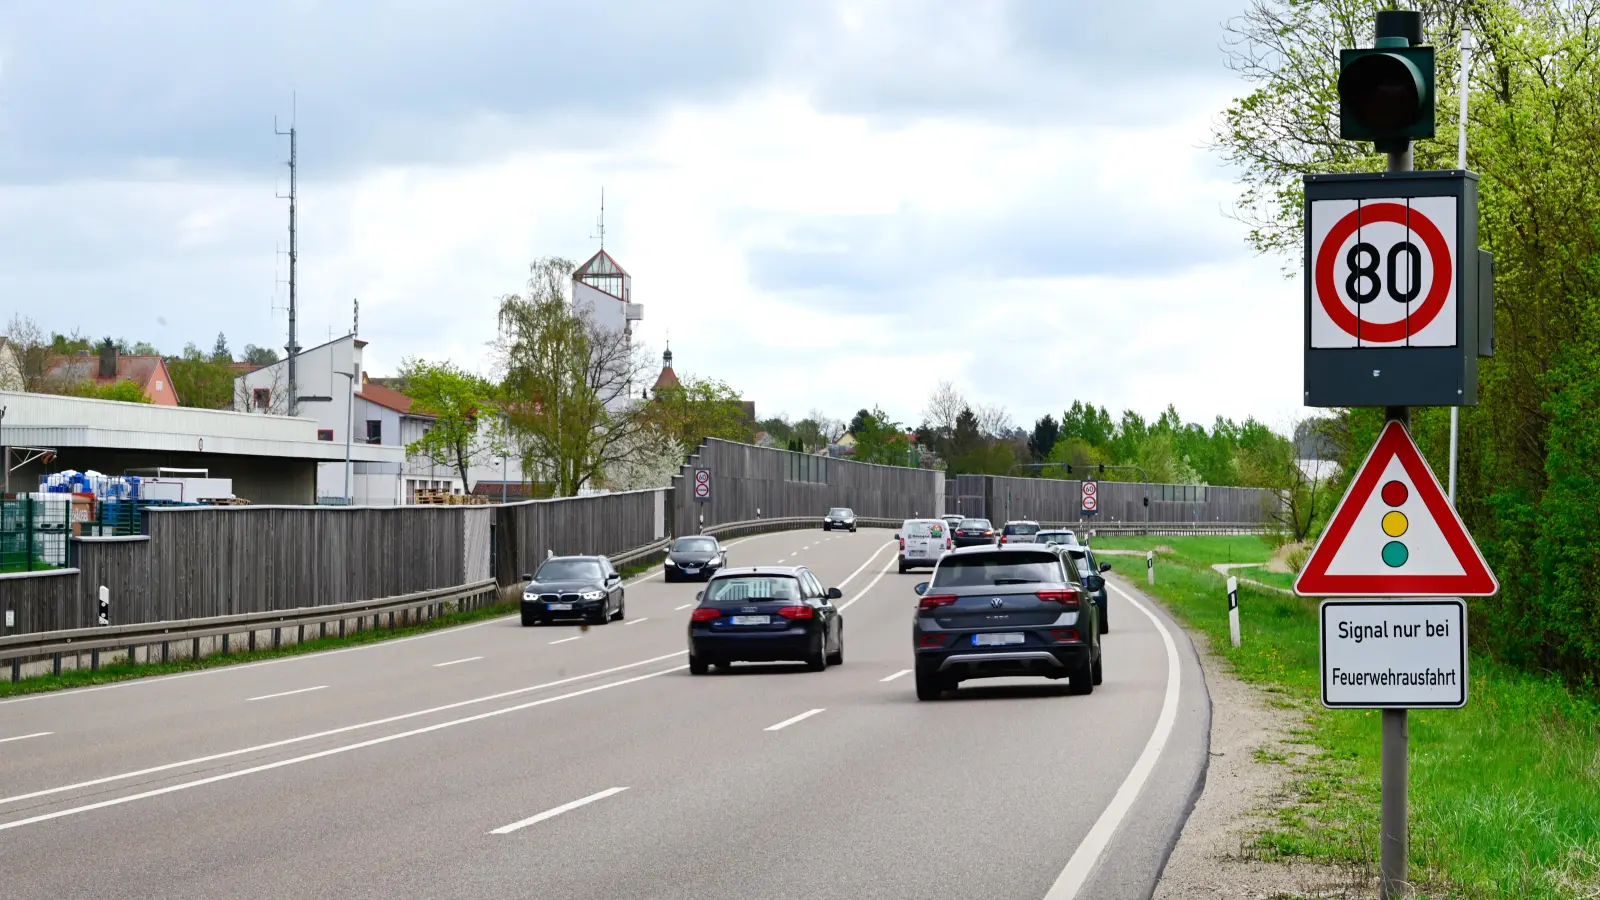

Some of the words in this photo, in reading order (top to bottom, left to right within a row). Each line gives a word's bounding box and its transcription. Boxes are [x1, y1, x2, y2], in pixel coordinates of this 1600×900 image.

[1345, 241, 1422, 304] 80
[1338, 620, 1389, 643] Signal
[1393, 623, 1421, 638] nur
[1425, 619, 1449, 637] bei
[1332, 667, 1456, 686] Feuerwehrausfahrt
